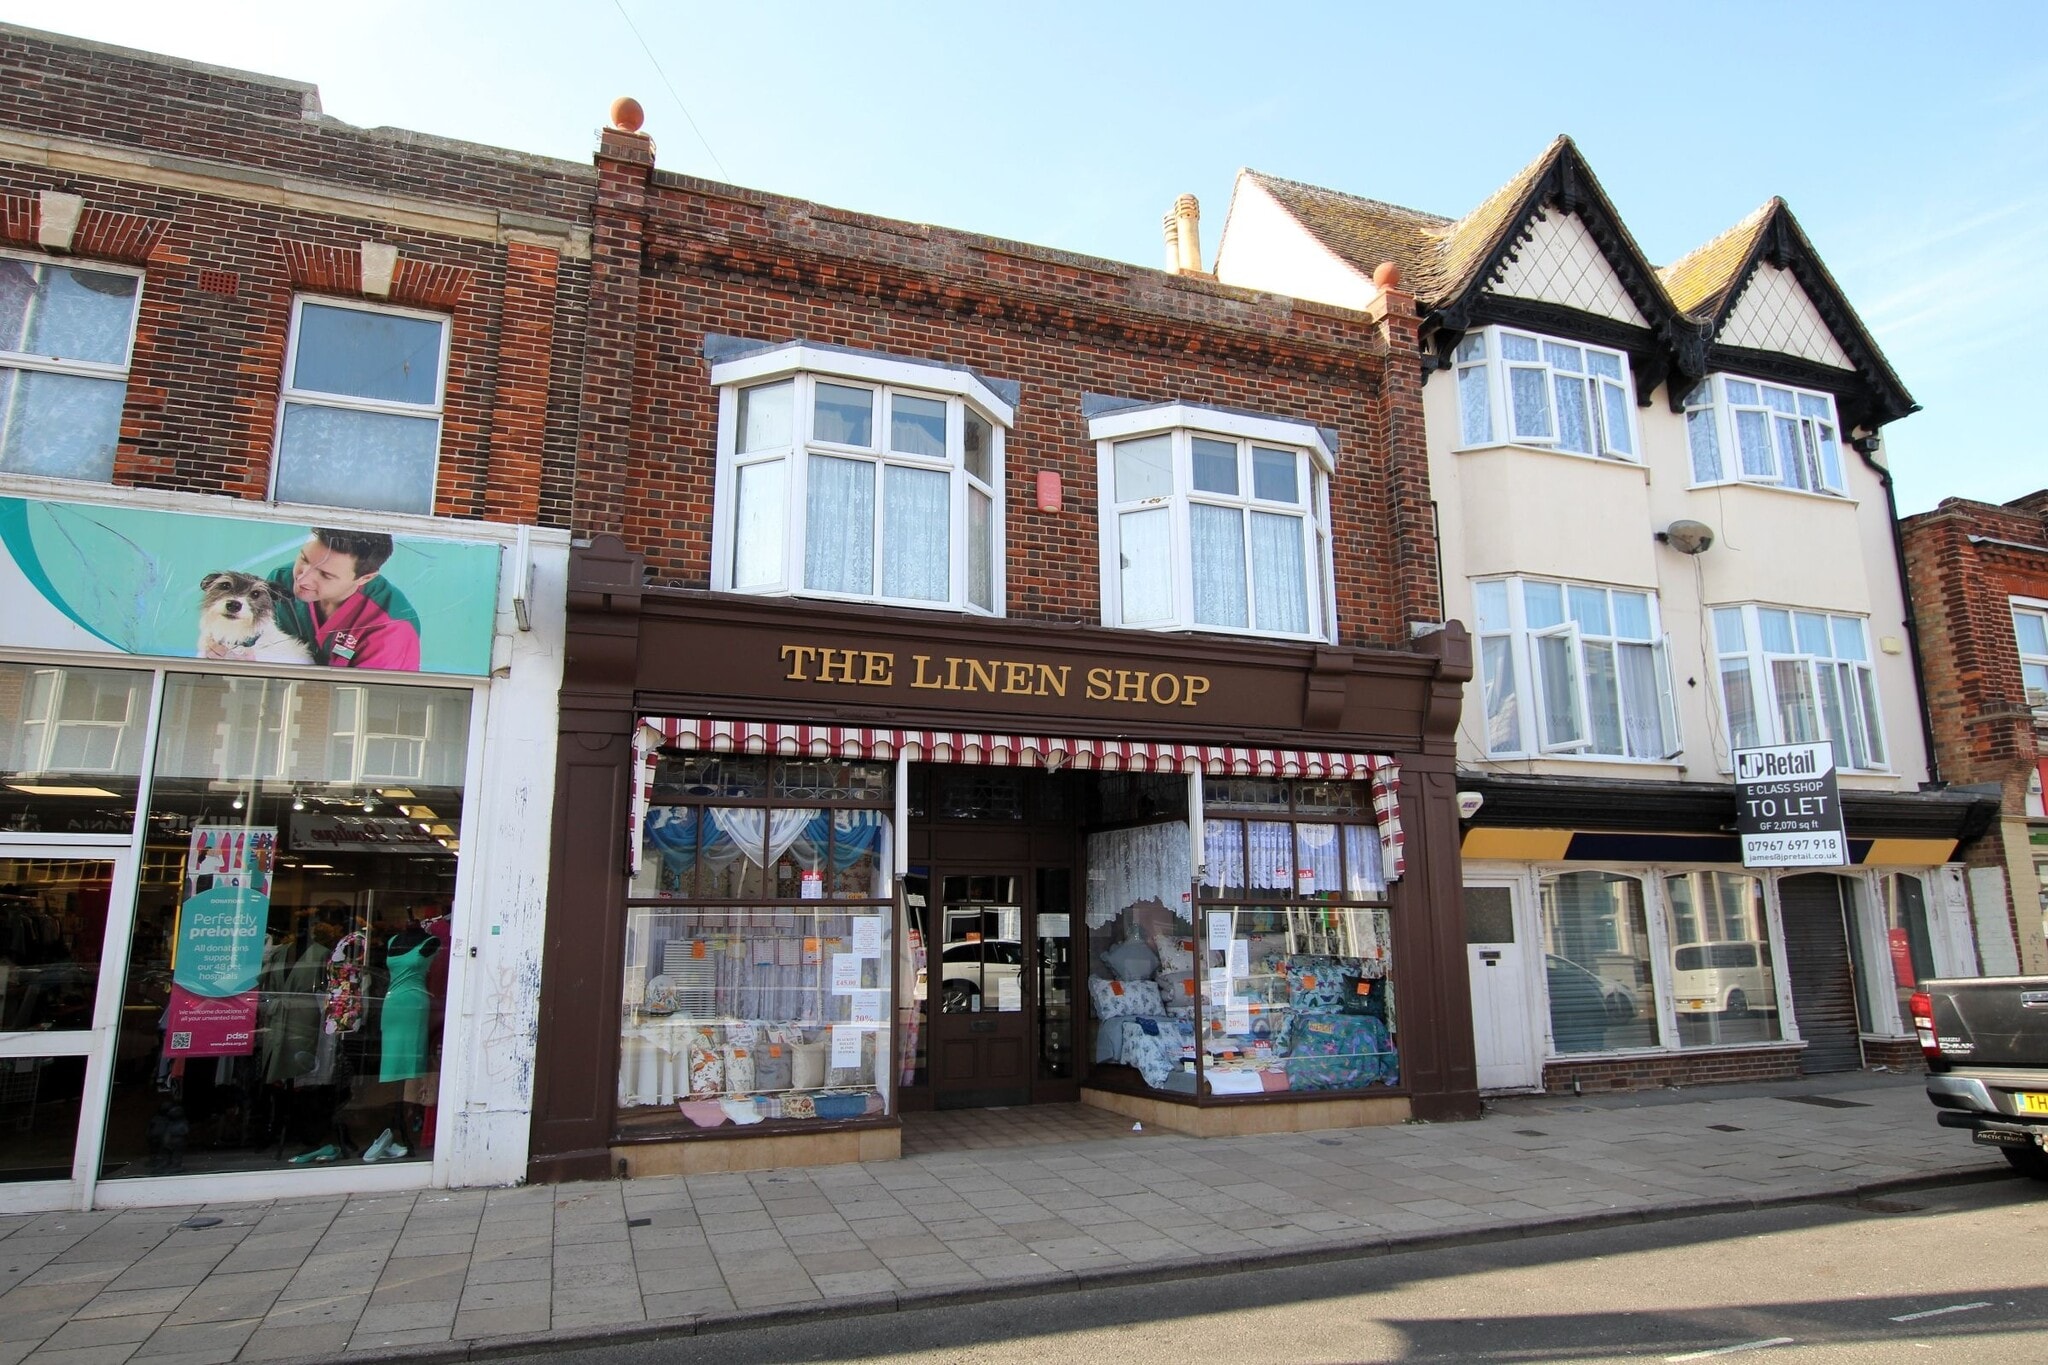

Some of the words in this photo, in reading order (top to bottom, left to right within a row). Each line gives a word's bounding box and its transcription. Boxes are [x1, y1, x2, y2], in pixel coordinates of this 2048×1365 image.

[781, 644, 895, 687] THE
[910, 654, 1071, 697] LINEN
[1085, 667, 1211, 706] SHOP
[1765, 749, 1816, 776] Retail
[1747, 786, 1755, 796] E
[1756, 784, 1791, 795] CLASS
[1793, 781, 1824, 793] SHOP
[1746, 799, 1777, 818] TO
[1784, 796, 1828, 816] LET
[1760, 822, 1772, 831] GF
[1774, 821, 1798, 831] 2,070
[1799, 821, 1810, 830] sq
[1811, 820, 1819, 829] ft
[1748, 841, 1784, 852] 07967
[1787, 840, 1809, 851] 697
[1813, 839, 1837, 850] 918
[1748, 852, 1838, 862] james@jpretail.co.uk
[194, 913, 257, 928] Perfectly
[189, 925, 257, 940] preloved
[194, 944, 206, 952] All
[206, 944, 249, 952] donations
[204, 954, 238, 962] support
[226, 963, 241, 973] pet
[199, 972, 238, 981] hospitals
[855, 1015, 874, 1023] 20%
[226, 1032, 249, 1041] pdsa
